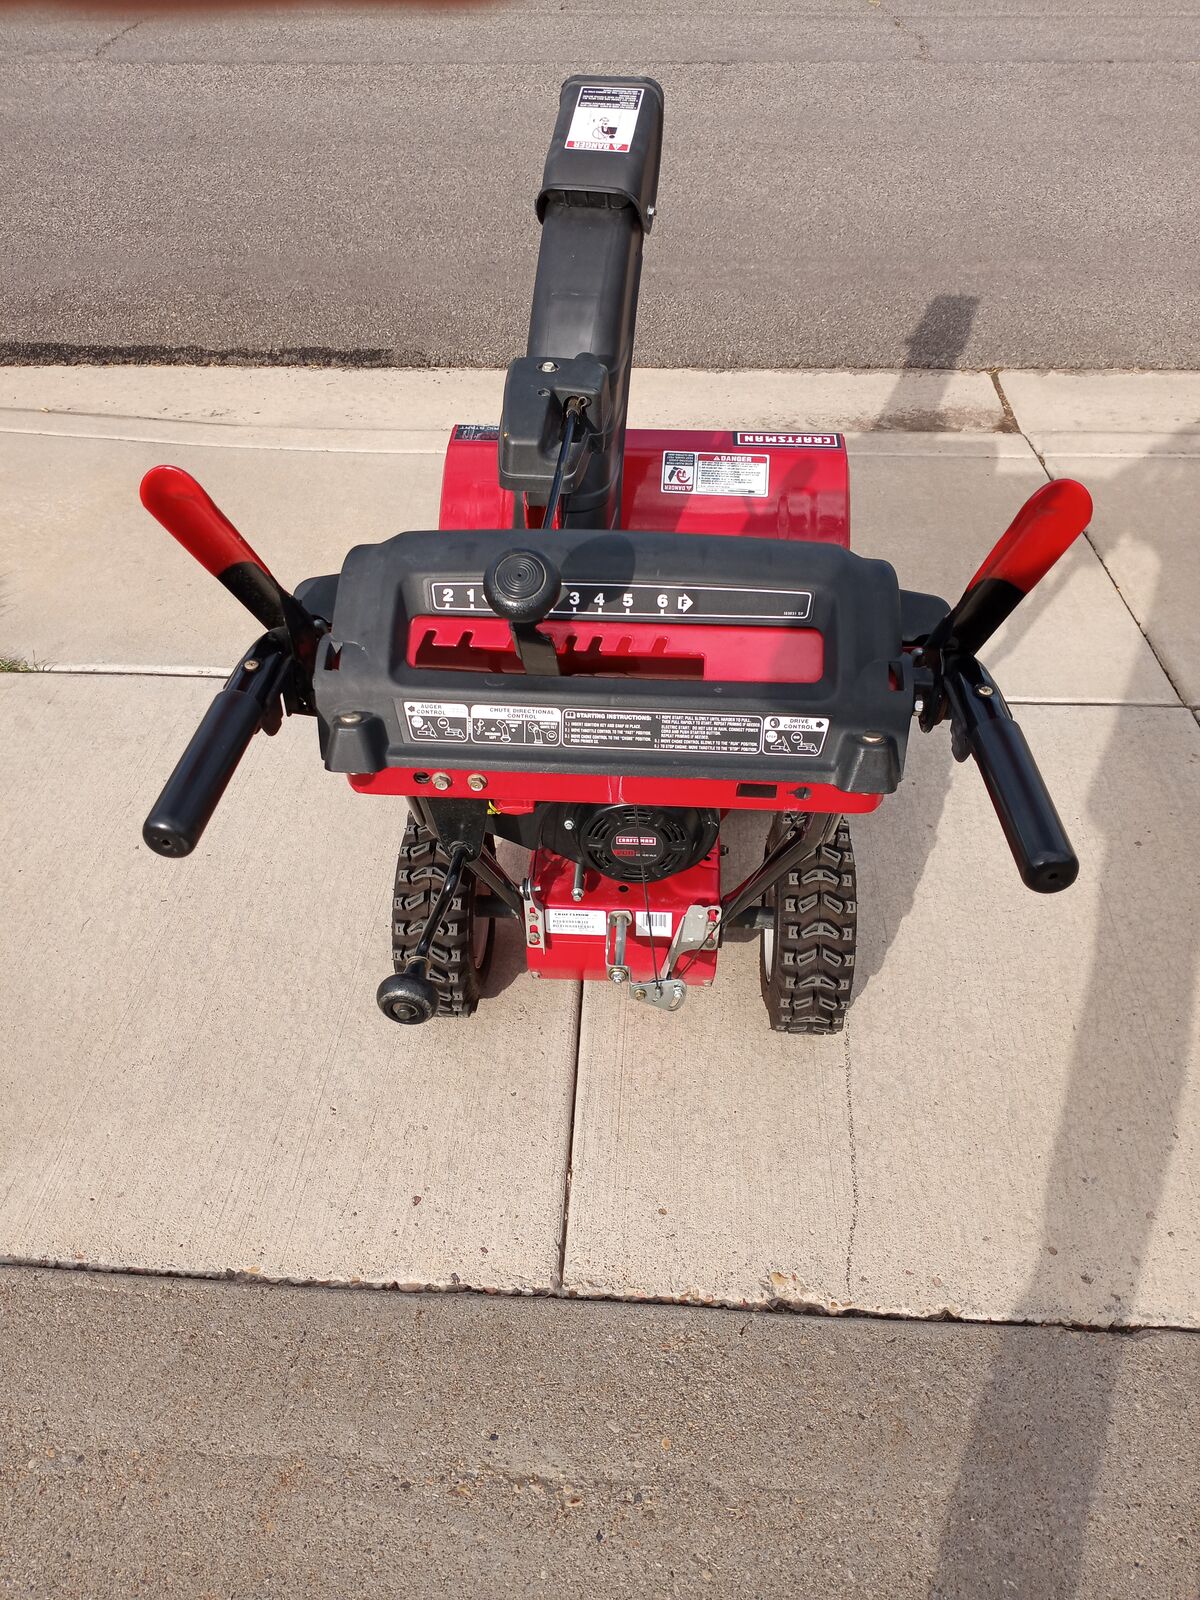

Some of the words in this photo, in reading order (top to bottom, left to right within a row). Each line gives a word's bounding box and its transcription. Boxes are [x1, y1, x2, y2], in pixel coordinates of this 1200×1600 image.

[574, 141, 610, 150] DANGER
[744, 435, 831, 444] CRAFTSMAN
[442, 588, 454, 602] 2
[466, 588, 474, 602] 1
[570, 592, 580, 606] 3
[594, 592, 605, 606] 4
[623, 594, 633, 606] 5
[657, 594, 668, 608] 6
